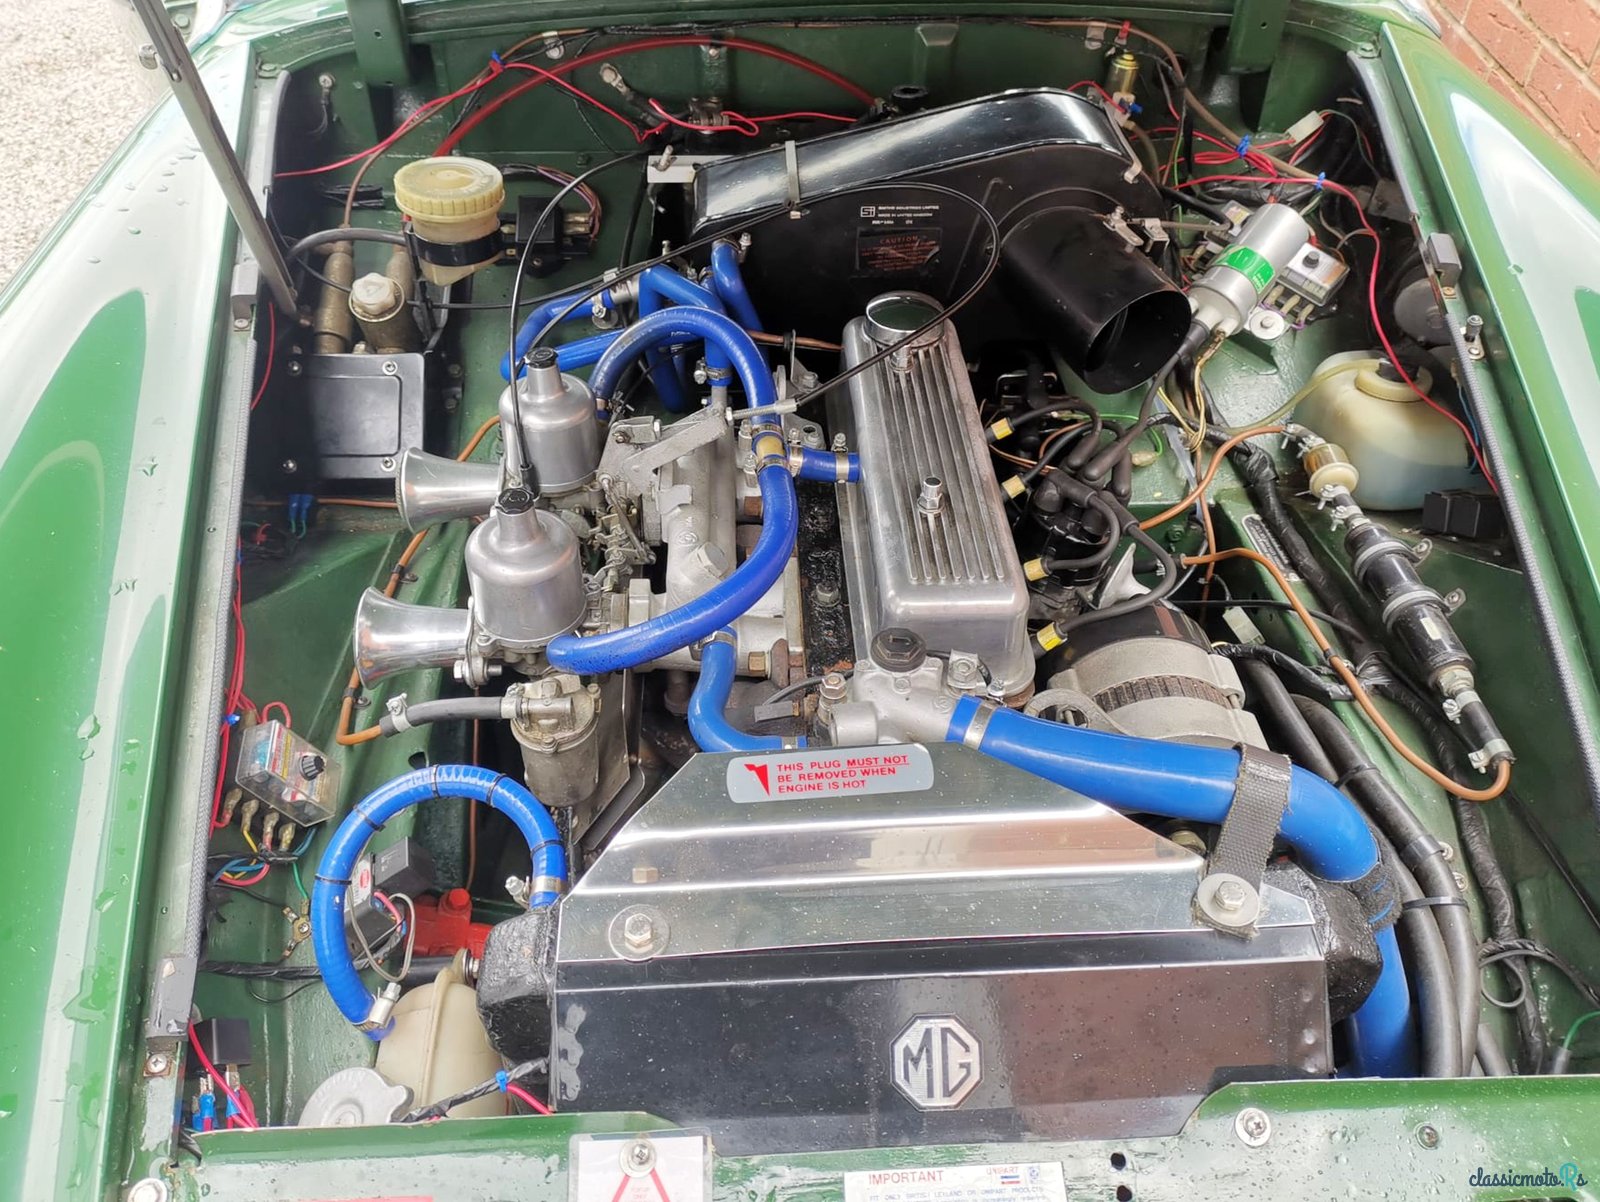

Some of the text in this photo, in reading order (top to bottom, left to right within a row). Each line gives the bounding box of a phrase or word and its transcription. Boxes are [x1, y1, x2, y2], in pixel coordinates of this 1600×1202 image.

[880, 236, 918, 244] CAUTION
[777, 755, 908, 772] THIS PLUG MUST NOT
[777, 767, 896, 783] BE REMOVED WHEN
[778, 780, 867, 793] ENGINE IS HOT
[902, 1026, 972, 1099] MG
[868, 1170, 944, 1185] IMPORTANT
[986, 1167, 1020, 1176] UNIPART
